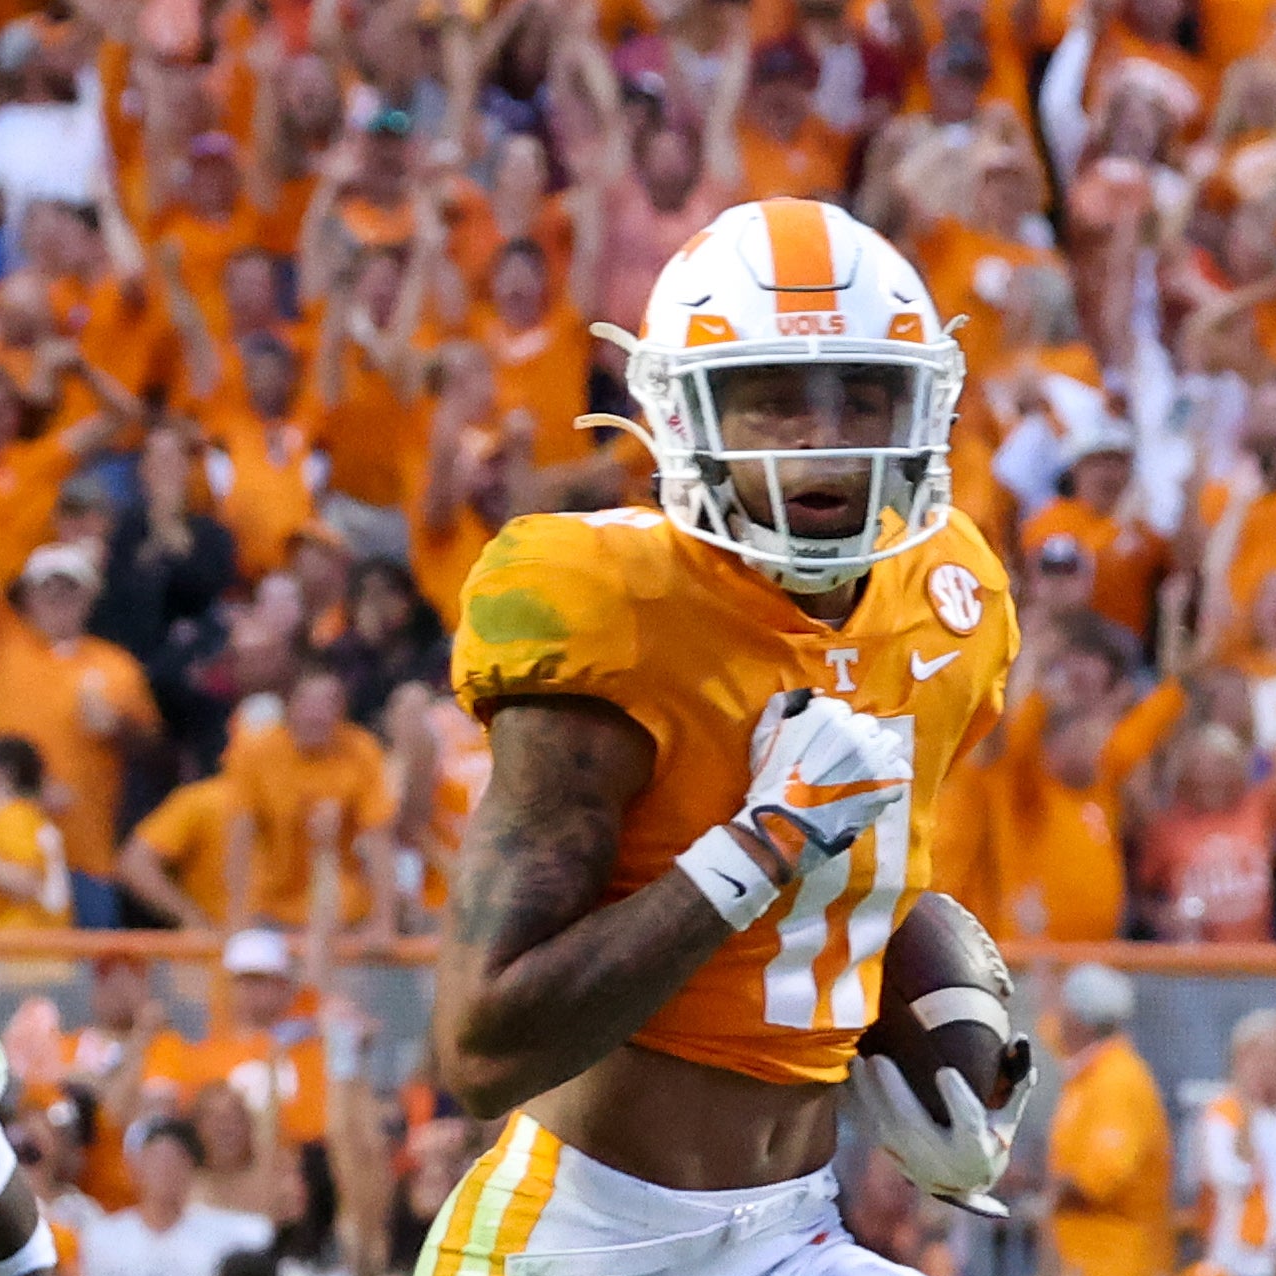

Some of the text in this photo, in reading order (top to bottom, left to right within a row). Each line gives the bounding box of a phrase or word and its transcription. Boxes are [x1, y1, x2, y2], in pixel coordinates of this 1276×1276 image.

[776, 313, 846, 336] VOLS
[927, 562, 983, 633] SEC
[826, 647, 859, 692] T
